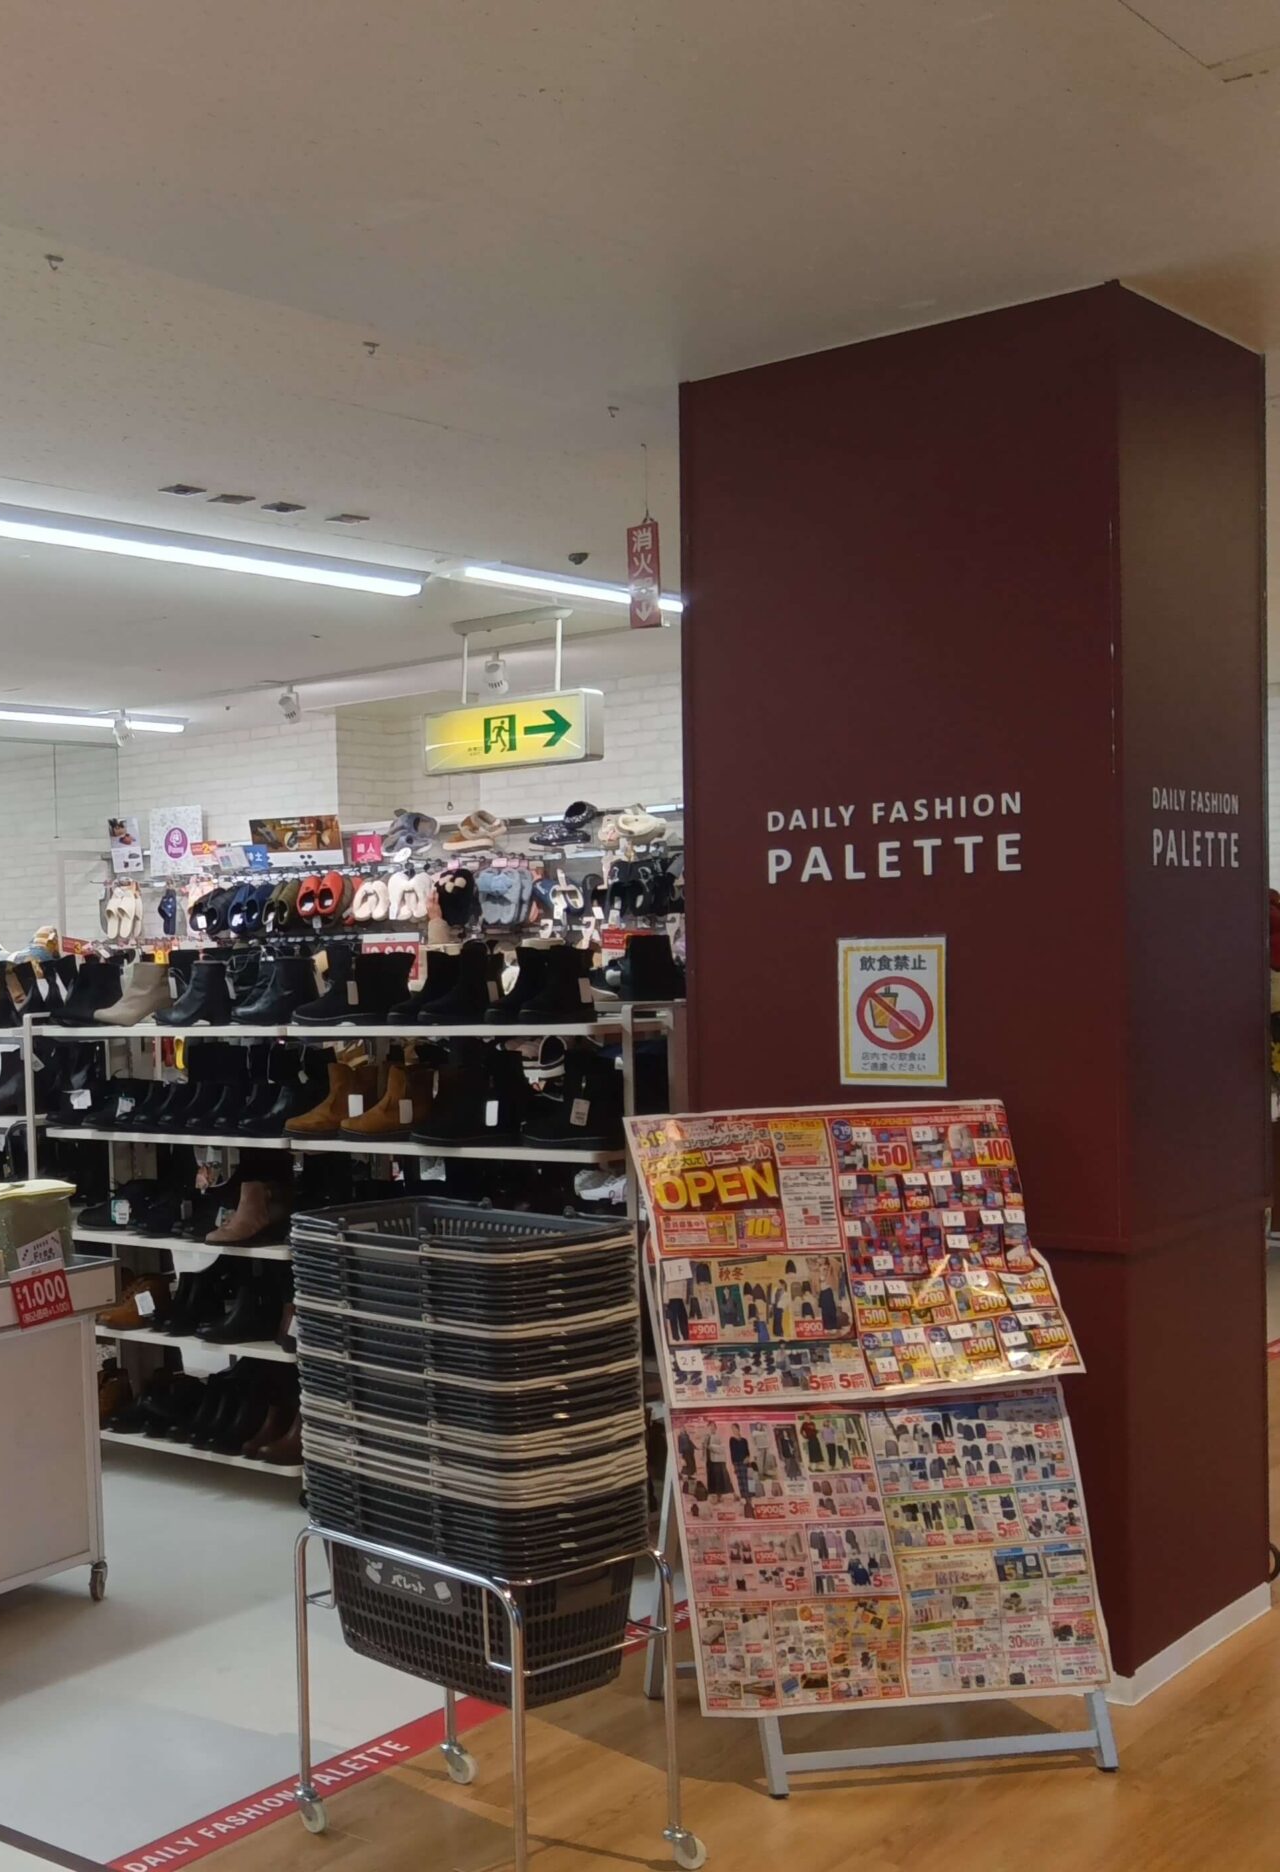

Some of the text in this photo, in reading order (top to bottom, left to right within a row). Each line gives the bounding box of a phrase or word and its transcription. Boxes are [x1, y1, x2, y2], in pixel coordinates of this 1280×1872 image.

[767, 791, 1021, 832] DAILY FASHION
[1152, 786, 1239, 815] DAILY FASHION
[767, 833, 1022, 884] PALETTE
[1152, 828, 1239, 868] PALETTE
[860, 954, 927, 971] 飲食禁止
[655, 1162, 779, 1210] OPEN
[718, 1267, 744, 1282] 秋冬
[123, 1739, 410, 1872] DAILY FASHION ALETTE
